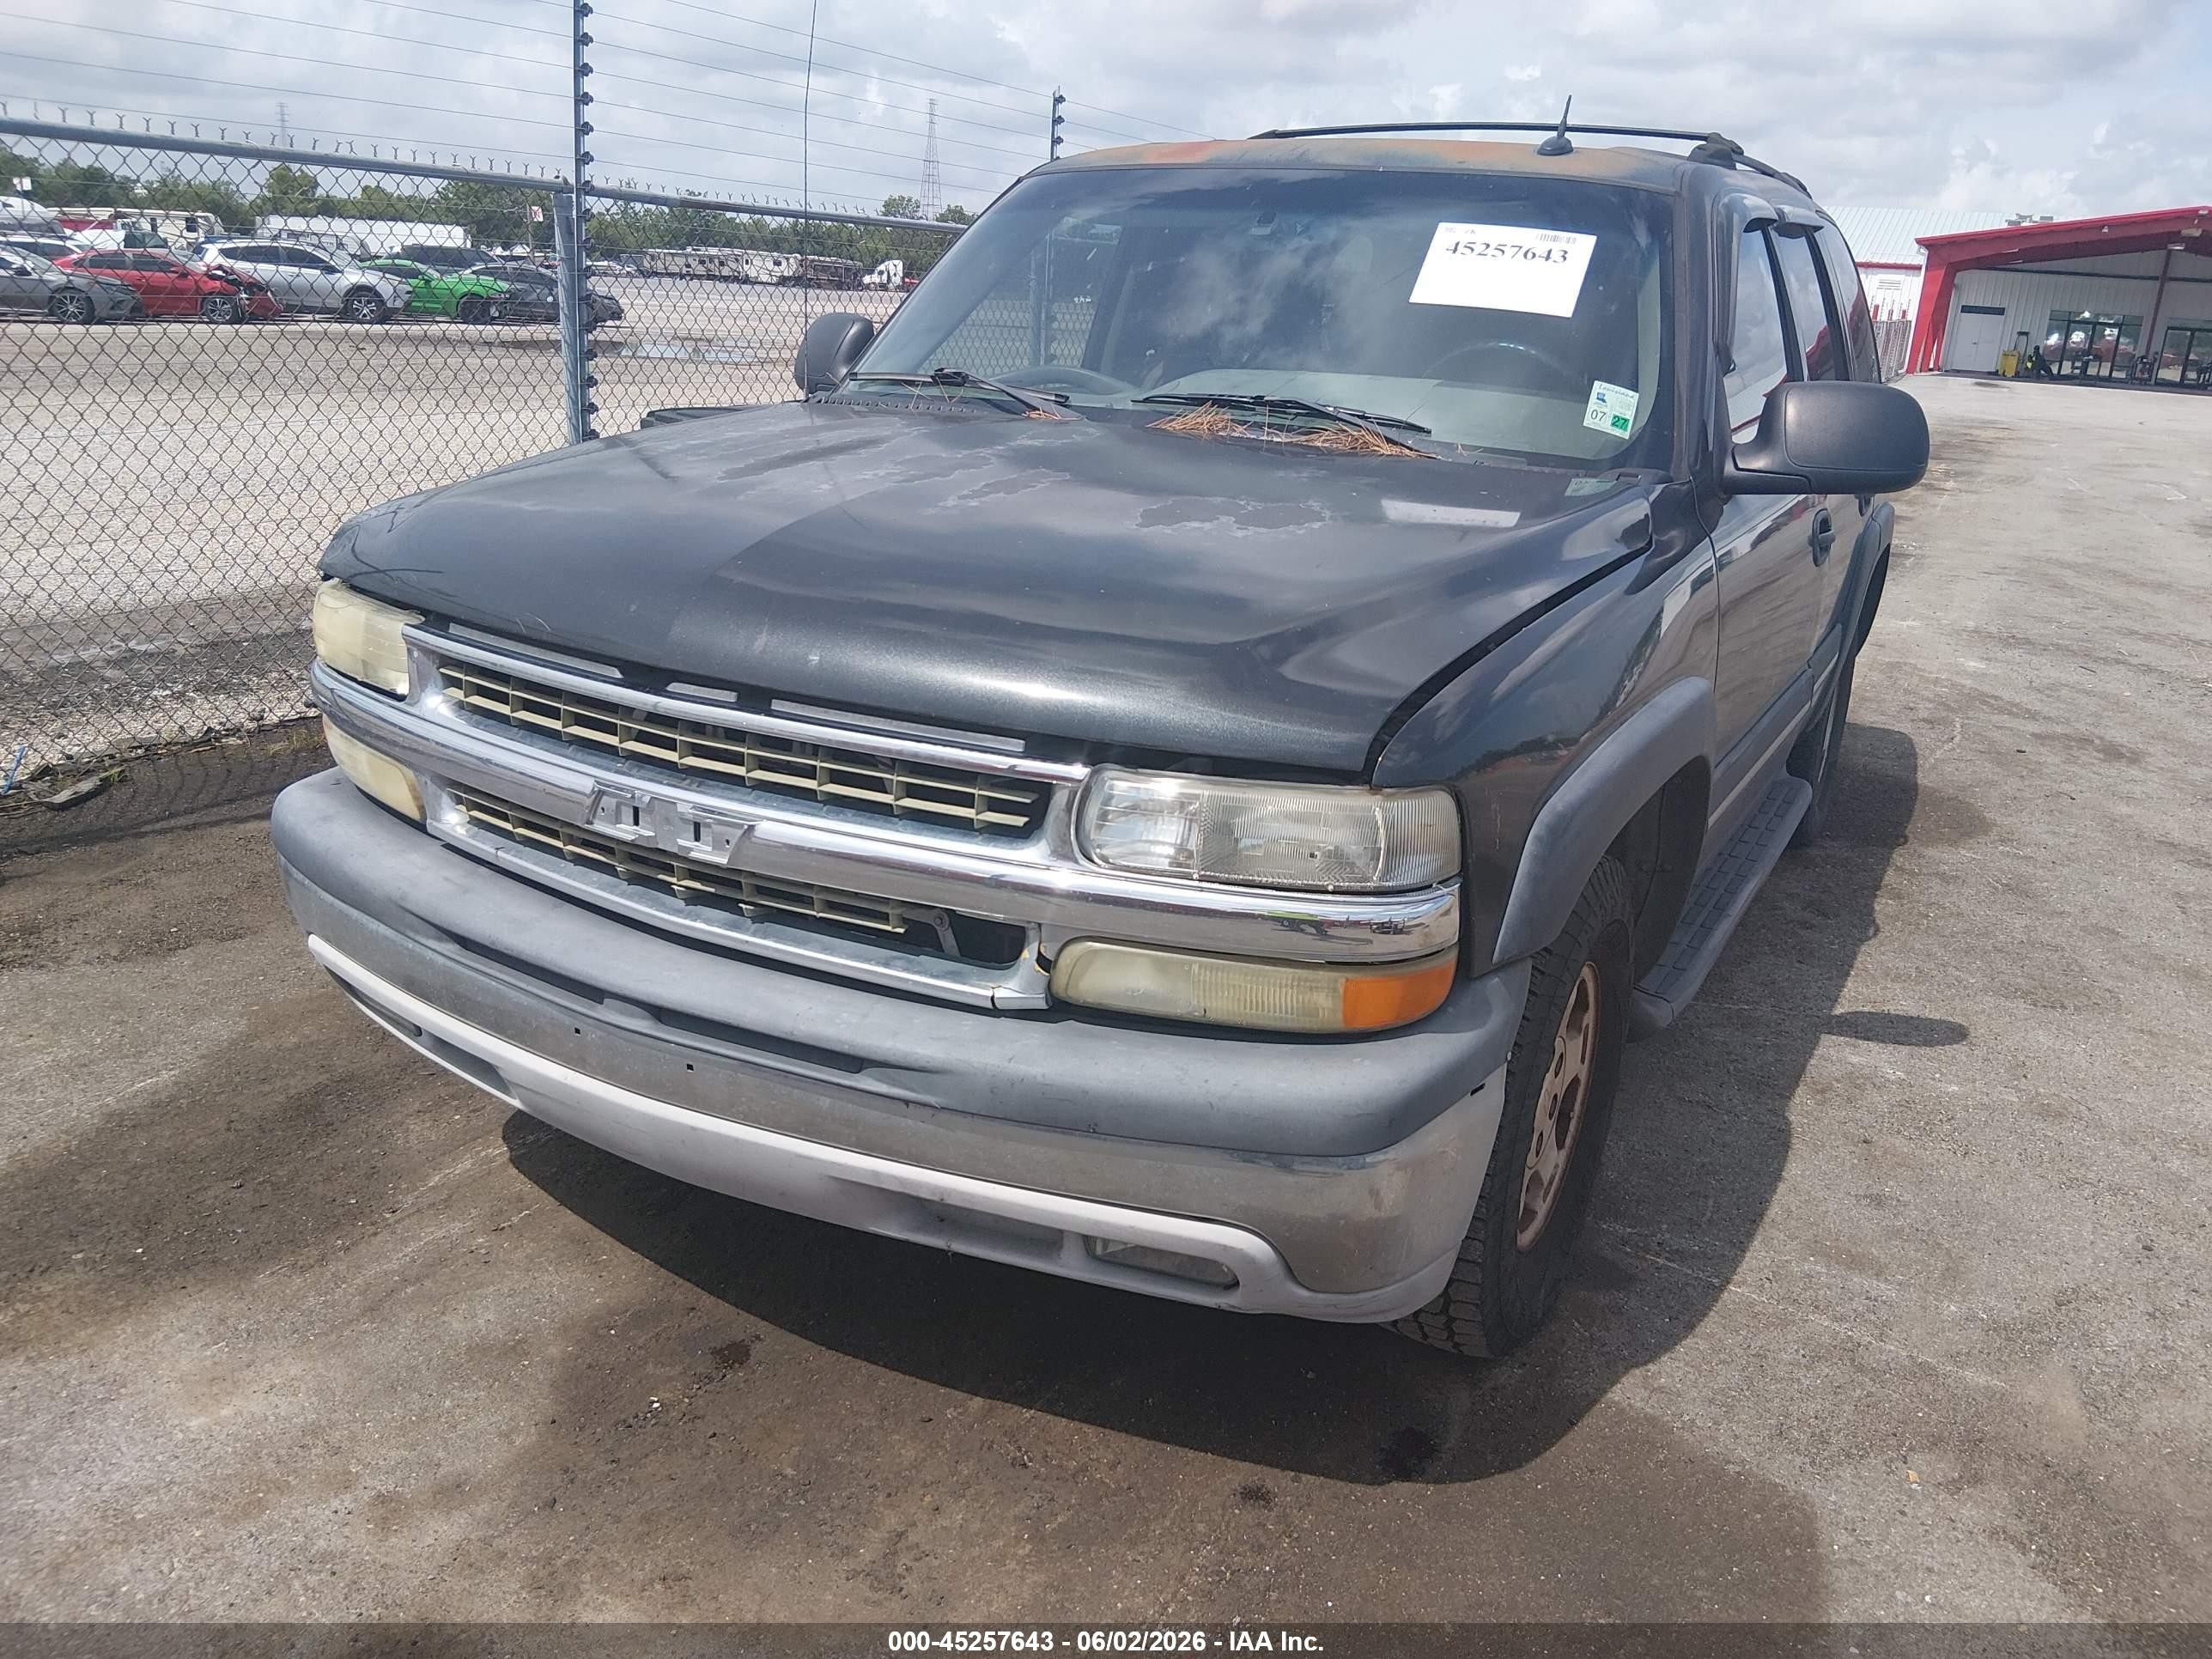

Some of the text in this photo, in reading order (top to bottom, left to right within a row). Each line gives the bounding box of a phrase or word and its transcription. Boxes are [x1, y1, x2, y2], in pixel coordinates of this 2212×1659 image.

[1445, 240, 1570, 264] 45257643
[1590, 409, 1607, 422] 07
[1611, 416, 1628, 429] 27
